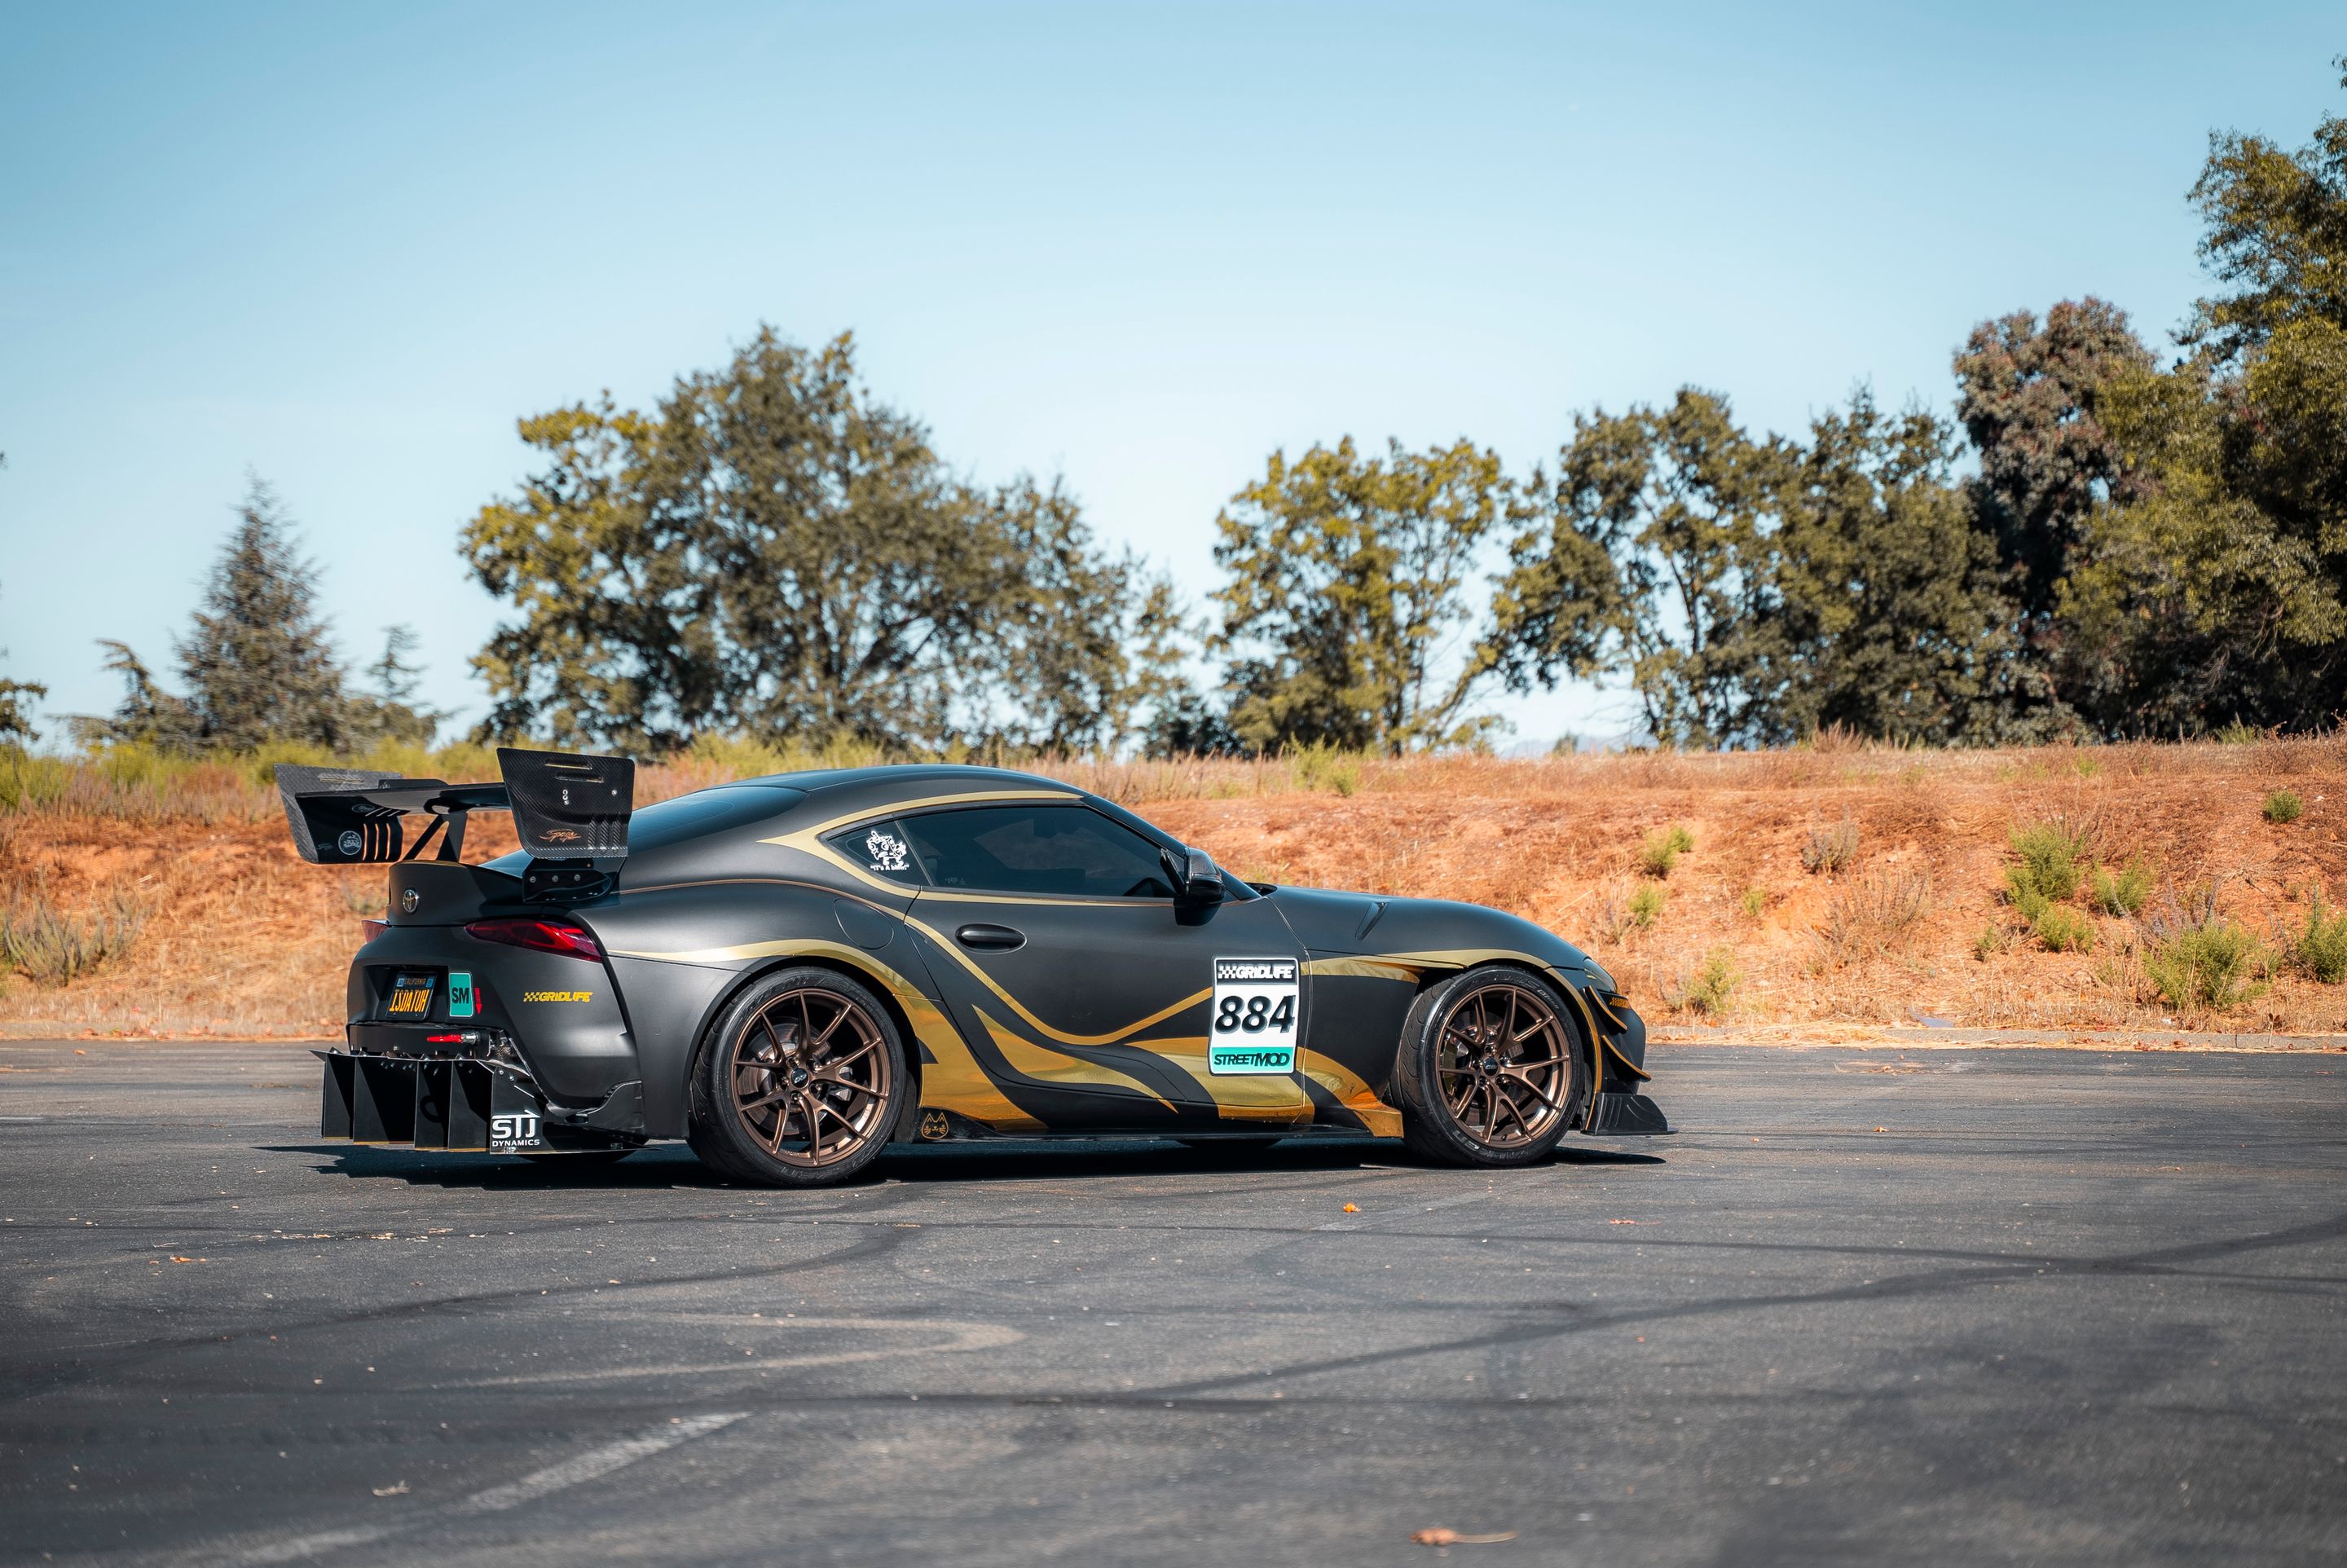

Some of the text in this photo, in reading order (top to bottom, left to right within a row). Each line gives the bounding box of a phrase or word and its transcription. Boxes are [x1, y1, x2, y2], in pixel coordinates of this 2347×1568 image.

[1235, 965, 1295, 979] GRIDLIFE
[451, 987, 469, 1005] SM
[539, 991, 593, 1002] GRIDLIFE
[1215, 995, 1296, 1034] 884
[1213, 1052, 1290, 1067] STREETMOD
[491, 1139, 540, 1147] DYNAMICS
